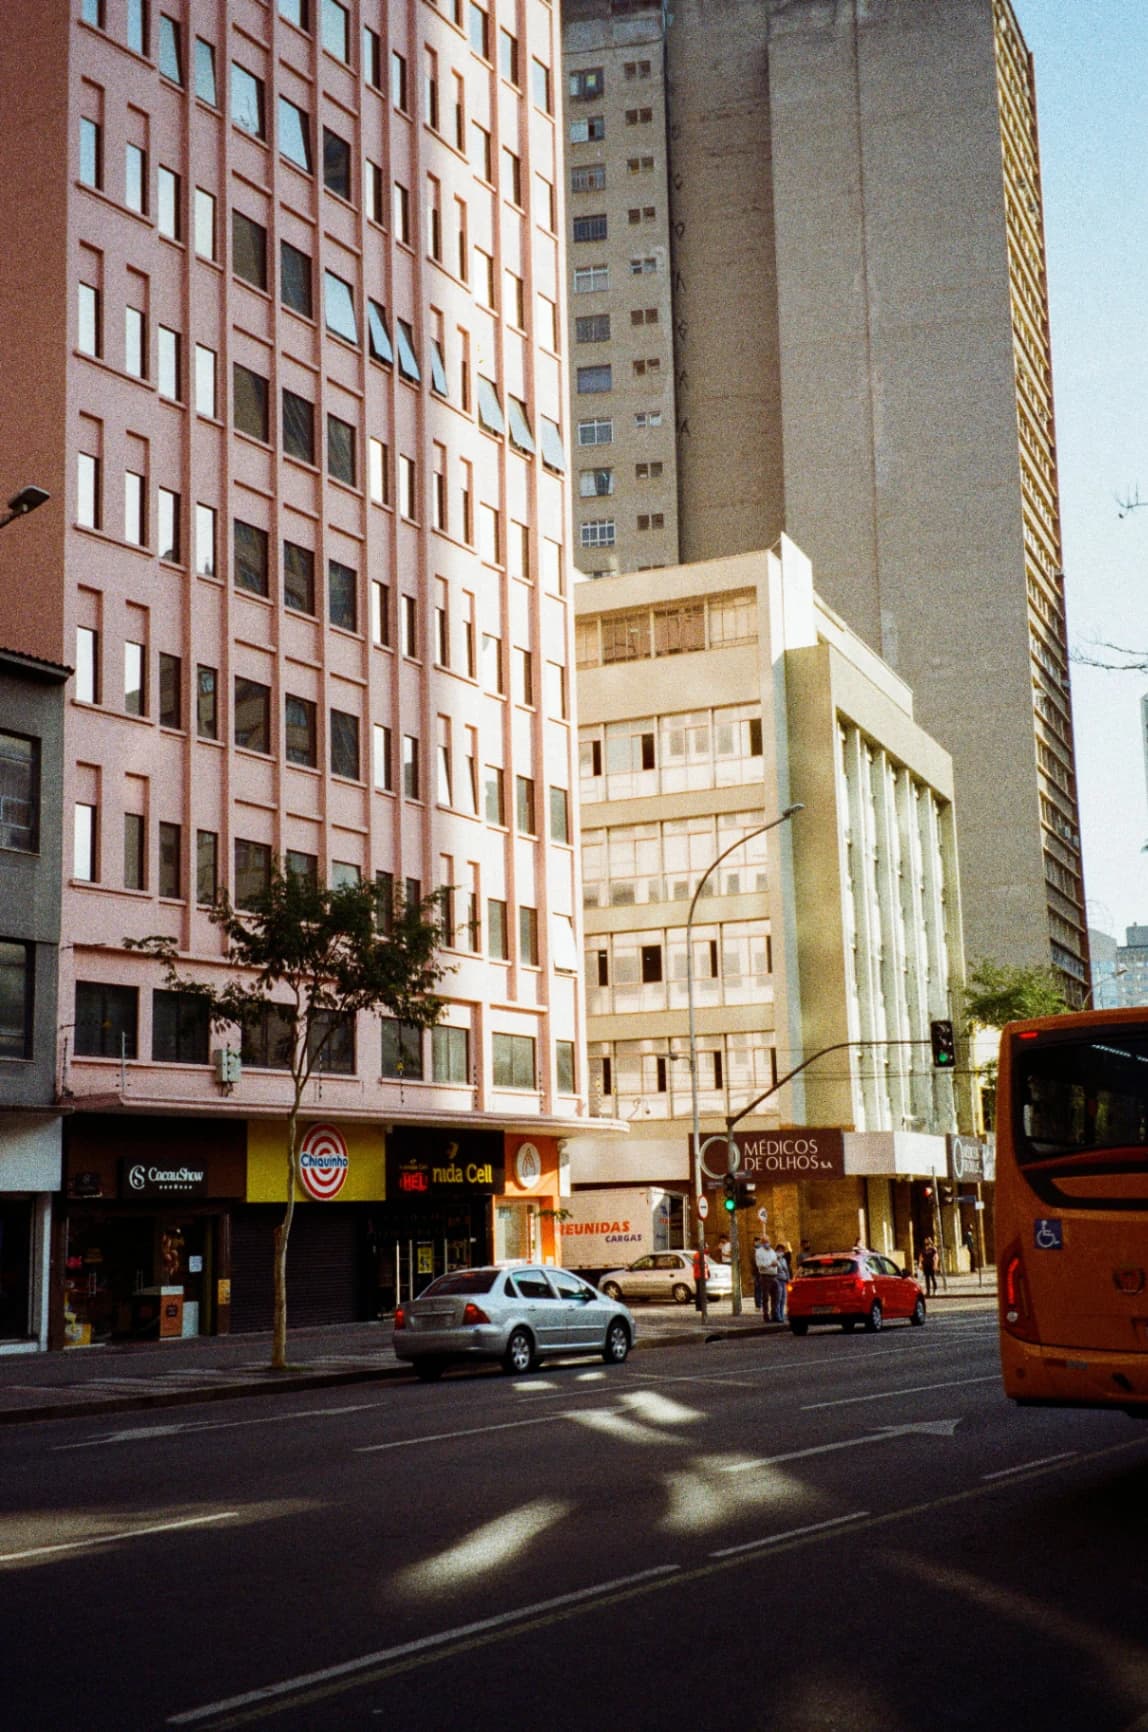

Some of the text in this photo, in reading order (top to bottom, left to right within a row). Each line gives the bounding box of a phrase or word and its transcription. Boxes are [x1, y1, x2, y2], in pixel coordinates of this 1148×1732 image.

[744, 1139, 818, 1156] MÉDICOS
[301, 1153, 348, 1167] Chiquinho
[744, 1157, 764, 1170] DE
[766, 1155, 819, 1170] OLHOS
[465, 1163, 493, 1183] Cell
[605, 1234, 642, 1243] CARGAS
